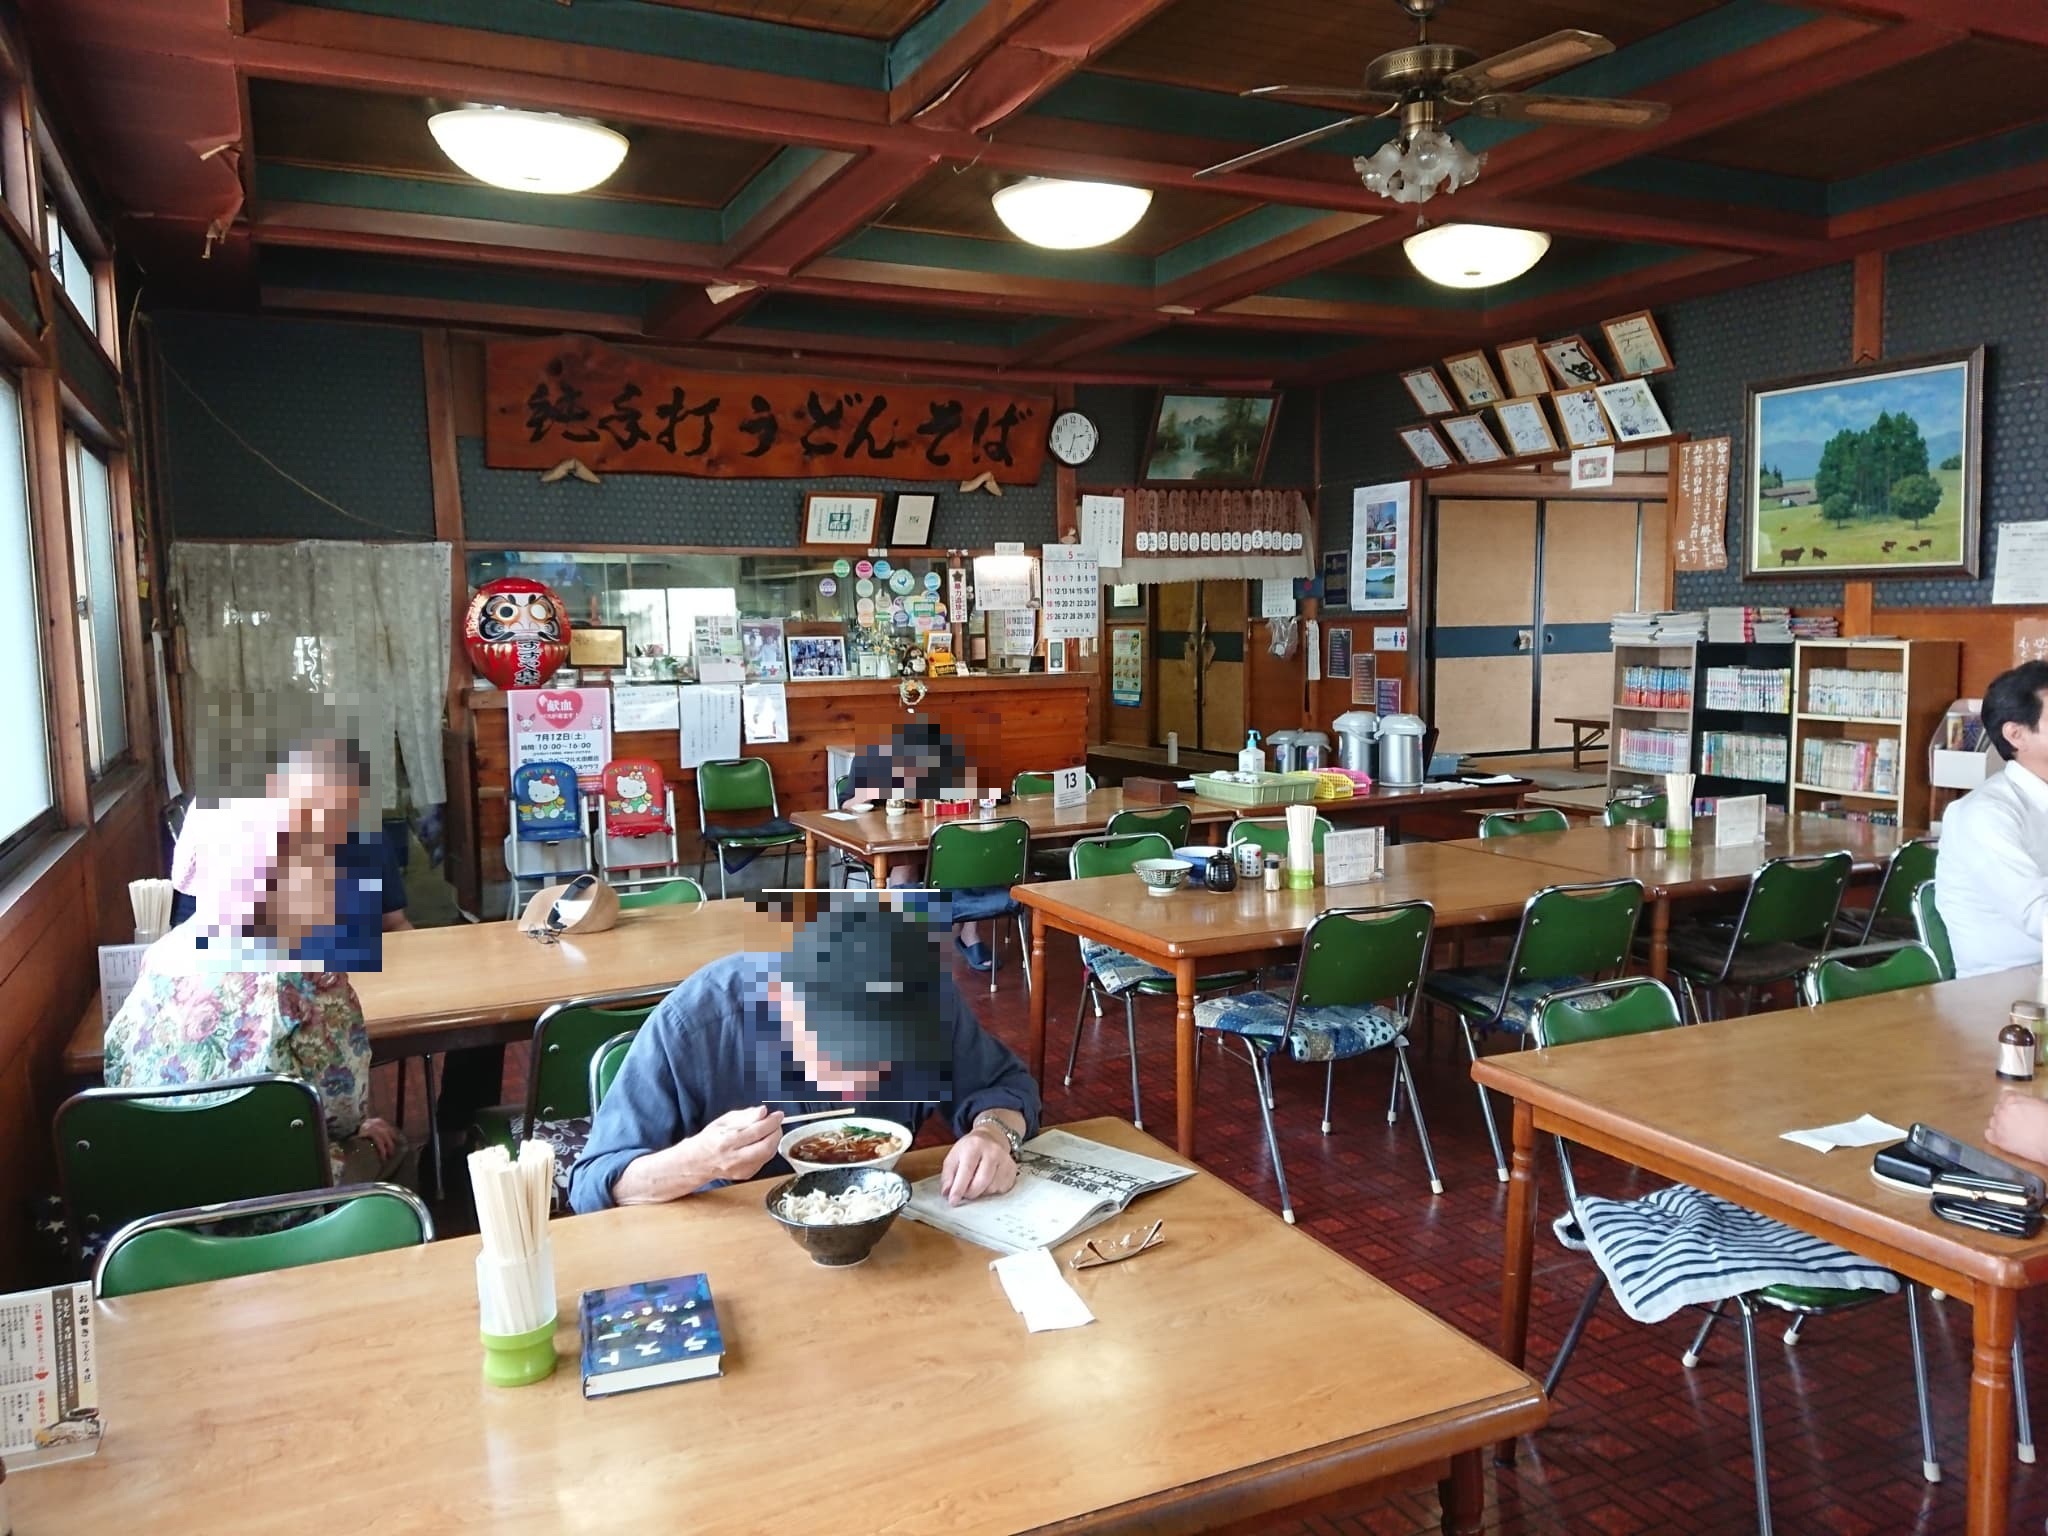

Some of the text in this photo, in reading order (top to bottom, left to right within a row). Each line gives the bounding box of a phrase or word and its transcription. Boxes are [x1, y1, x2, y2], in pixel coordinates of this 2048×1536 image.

[1068, 551, 1073, 559] 5
[547, 699, 573, 712] 献血
[1065, 772, 1077, 789] 13
[598, 1316, 701, 1341] レター
[598, 1335, 707, 1366] ラスト
